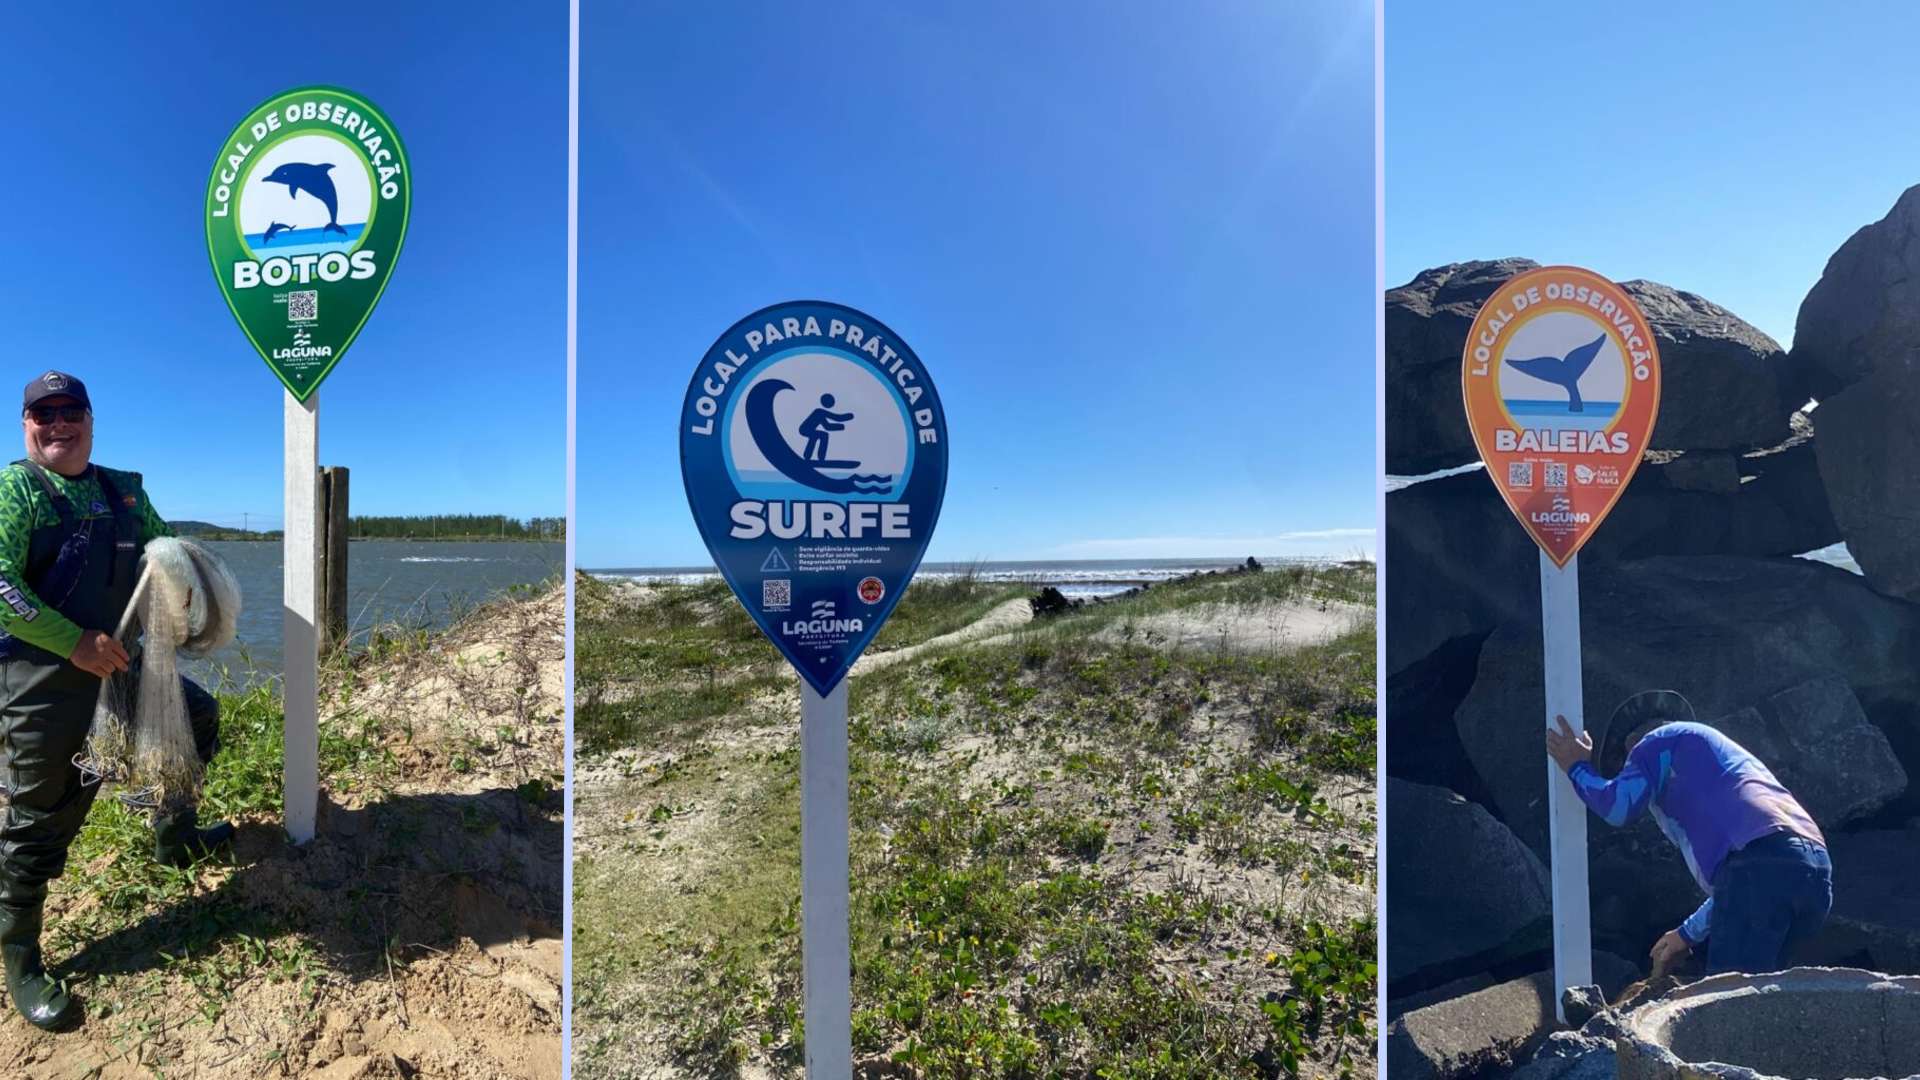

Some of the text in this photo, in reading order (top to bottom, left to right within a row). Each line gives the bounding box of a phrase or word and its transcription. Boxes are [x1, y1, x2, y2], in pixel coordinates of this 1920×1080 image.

[213, 102, 400, 217] LOCAL DE OBSERVAÇÃO
[234, 250, 376, 288] BOTOS
[1472, 283, 1651, 381] LOCAL DE OBSERVAÇÃO
[273, 346, 332, 359] LAGUNA
[692, 316, 938, 444] LOCAL PARA PRÁTICA DE
[1495, 430, 1630, 454] BALEIAS
[730, 501, 911, 539] SURFE
[1532, 512, 1590, 523] LAGUNA
[783, 619, 863, 635] LAGUNA
